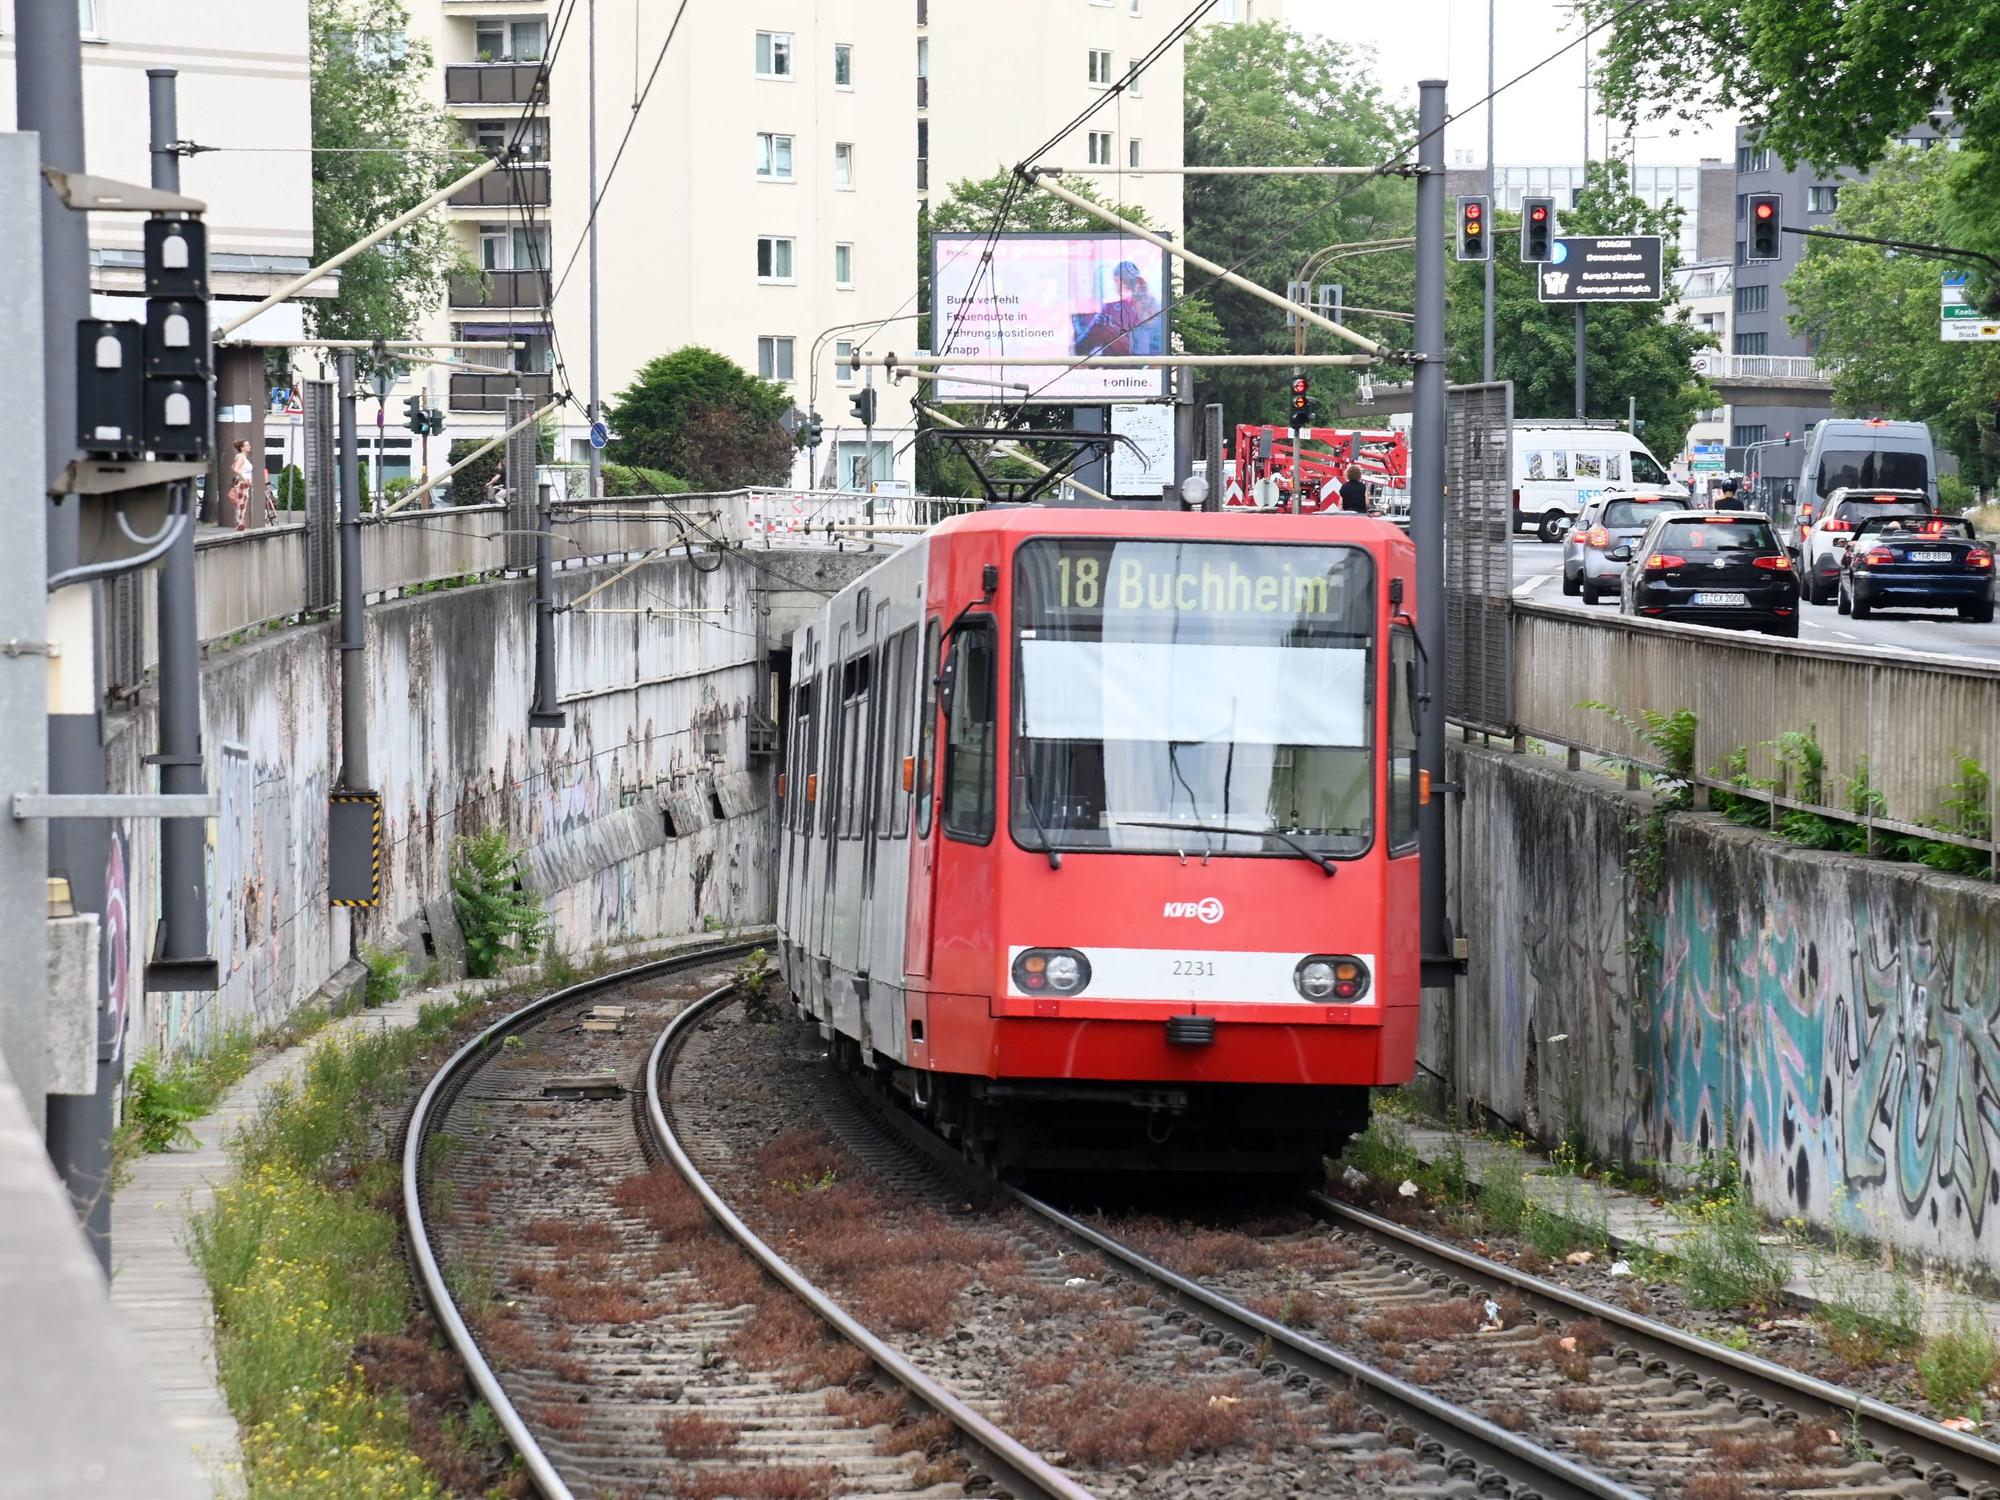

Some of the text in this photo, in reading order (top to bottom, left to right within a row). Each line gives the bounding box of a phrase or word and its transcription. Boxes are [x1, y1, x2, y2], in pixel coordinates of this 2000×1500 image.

[977, 295, 1019, 305] verfehlt
[1058, 557, 1328, 614] 18 Buchheim
[1163, 902, 1198, 918] KVB
[1172, 960, 1215, 976] 2231
